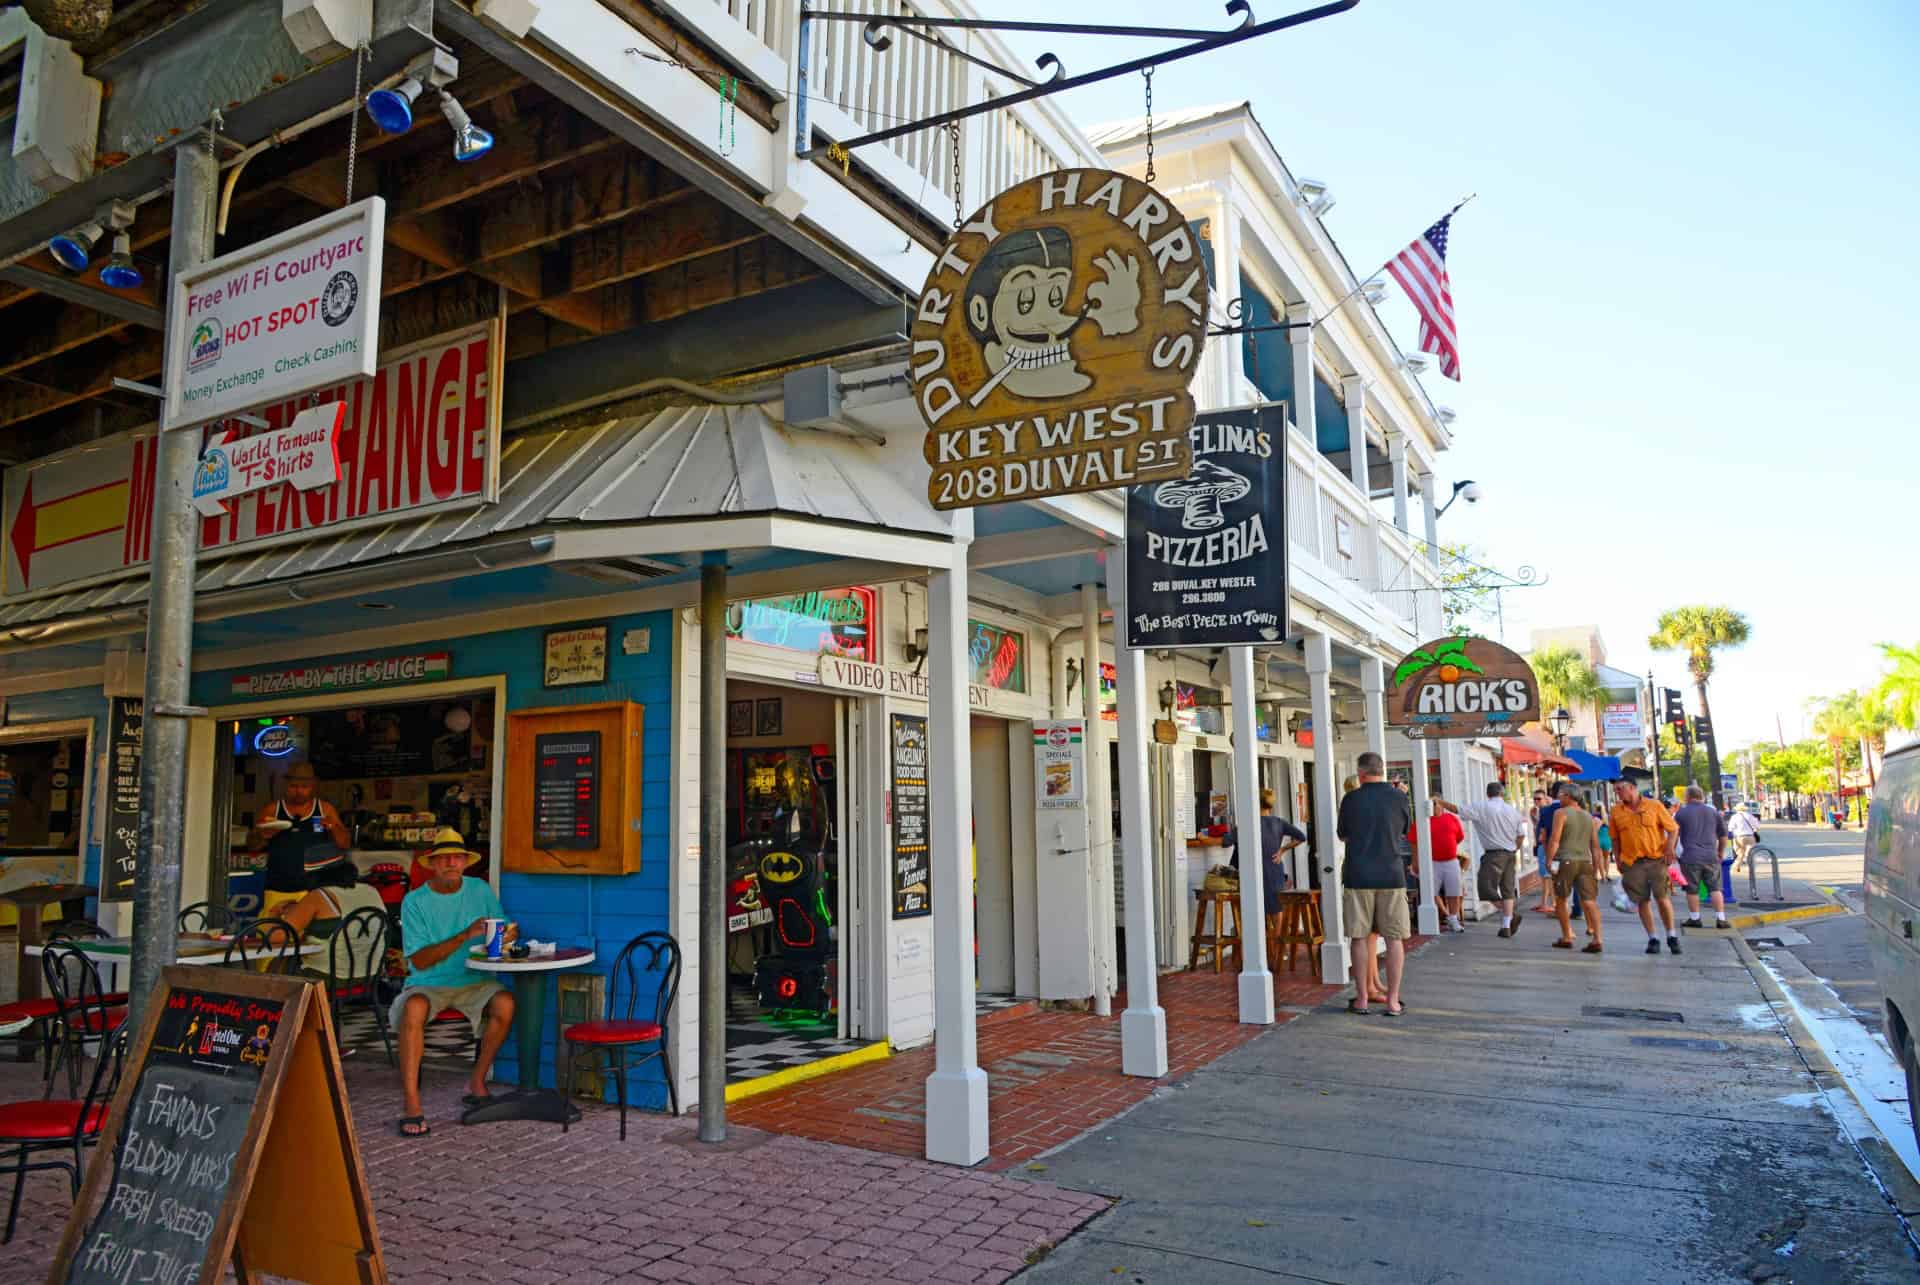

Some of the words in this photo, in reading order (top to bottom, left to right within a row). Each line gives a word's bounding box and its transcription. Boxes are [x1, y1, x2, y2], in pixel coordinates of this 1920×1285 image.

[188, 289, 222, 316] Free
[227, 274, 248, 300] Wi
[253, 266, 269, 291] Fi
[913, 206, 1001, 424] DURTY
[224, 316, 263, 347] HOT
[267, 297, 320, 333] SPOT
[183, 383, 215, 401] Money
[216, 366, 265, 393] Exchange
[274, 351, 311, 373] Check
[231, 437, 271, 466] World
[276, 428, 326, 453] Famous
[938, 420, 1025, 464] KEY
[1033, 396, 1177, 450] WEST
[1188, 423, 1273, 458] ELINA'S
[239, 450, 314, 487] T-Shirts
[937, 467, 998, 503] 208
[1003, 447, 1135, 497] DUVAL
[1137, 438, 1180, 464] ST
[1146, 512, 1269, 568] PIZZERIA
[250, 674, 298, 695] PIZZA
[302, 670, 325, 689] BY
[332, 663, 367, 686] THE
[373, 655, 426, 681] SLICE
[834, 660, 884, 690] VIDEO
[1418, 678, 1528, 714] RICK'S
[898, 852, 918, 874] World
[904, 867, 928, 887] Famous
[191, 996, 244, 1022] Proudly
[148, 1083, 221, 1140] FAMOUS
[120, 1128, 187, 1185] BLOODY
[83, 1231, 148, 1284] FRUIT
